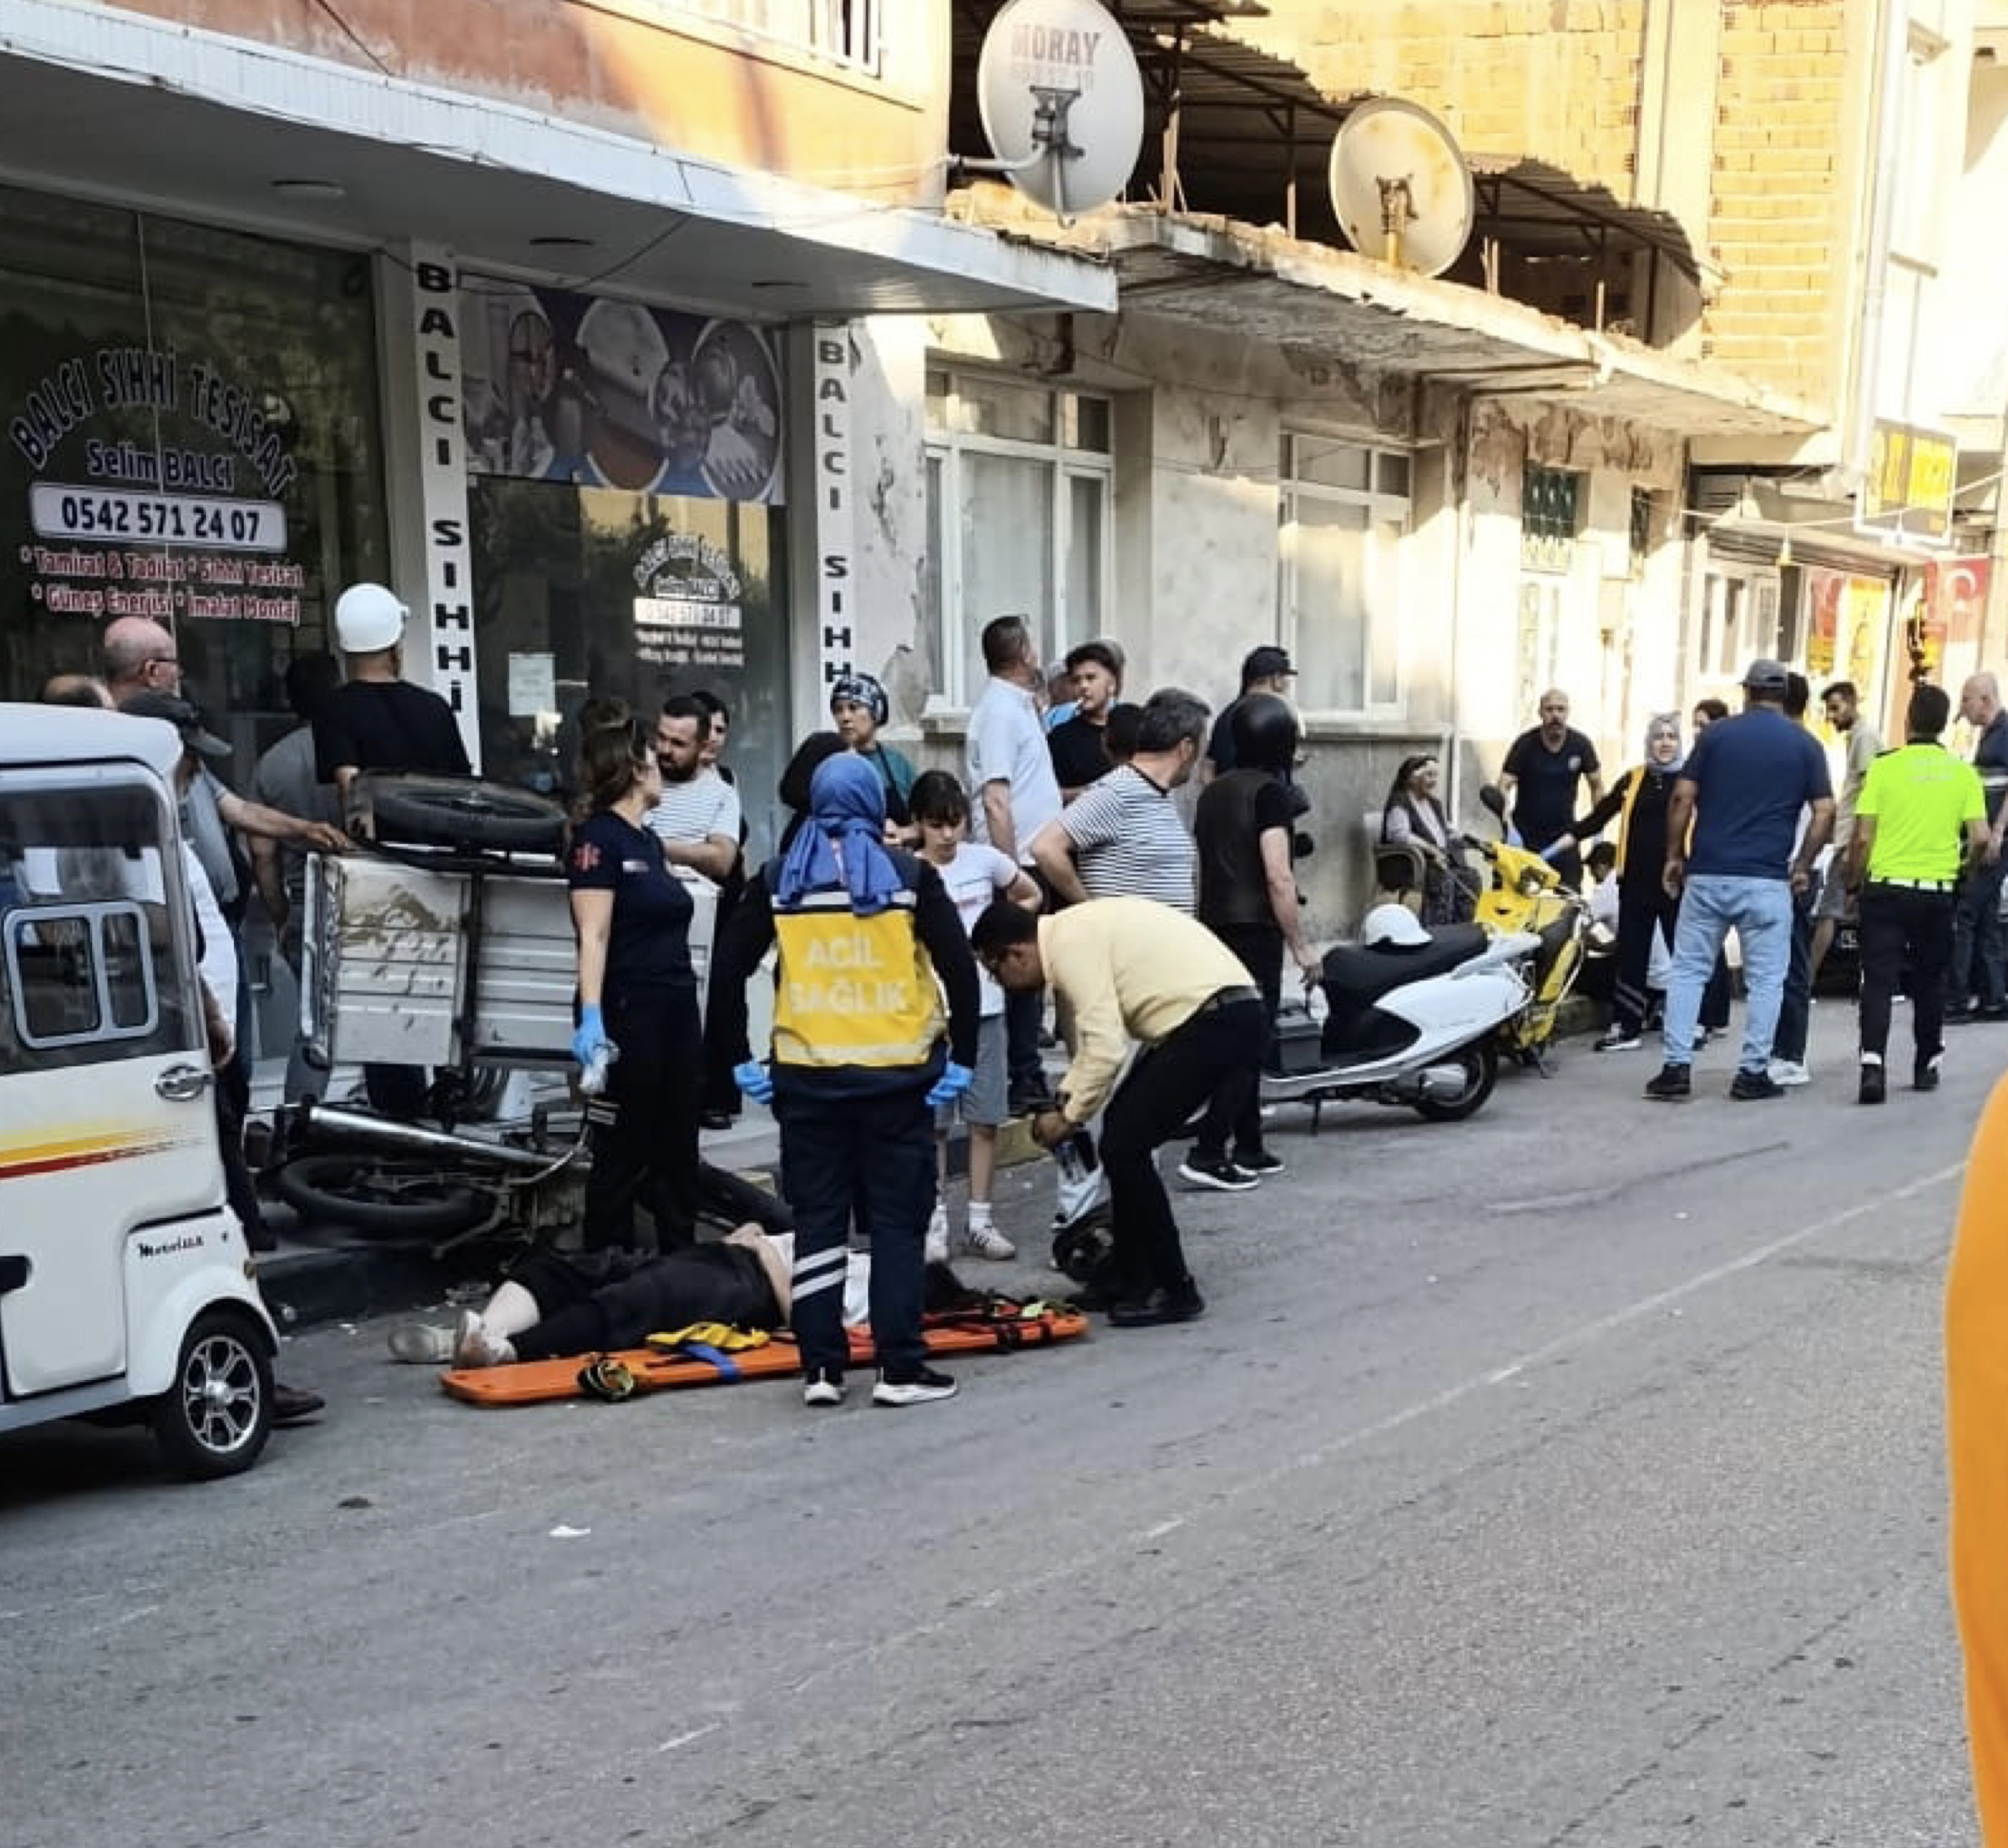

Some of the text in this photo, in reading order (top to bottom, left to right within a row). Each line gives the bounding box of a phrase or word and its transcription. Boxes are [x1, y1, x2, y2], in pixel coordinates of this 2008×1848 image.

[61, 496, 261, 542] 0542 571 24 07
[87, 439, 235, 492] Selim BALCI
[418, 262, 471, 713] BALCI SIHHİ
[819, 340, 851, 683] BALCI SIHH
